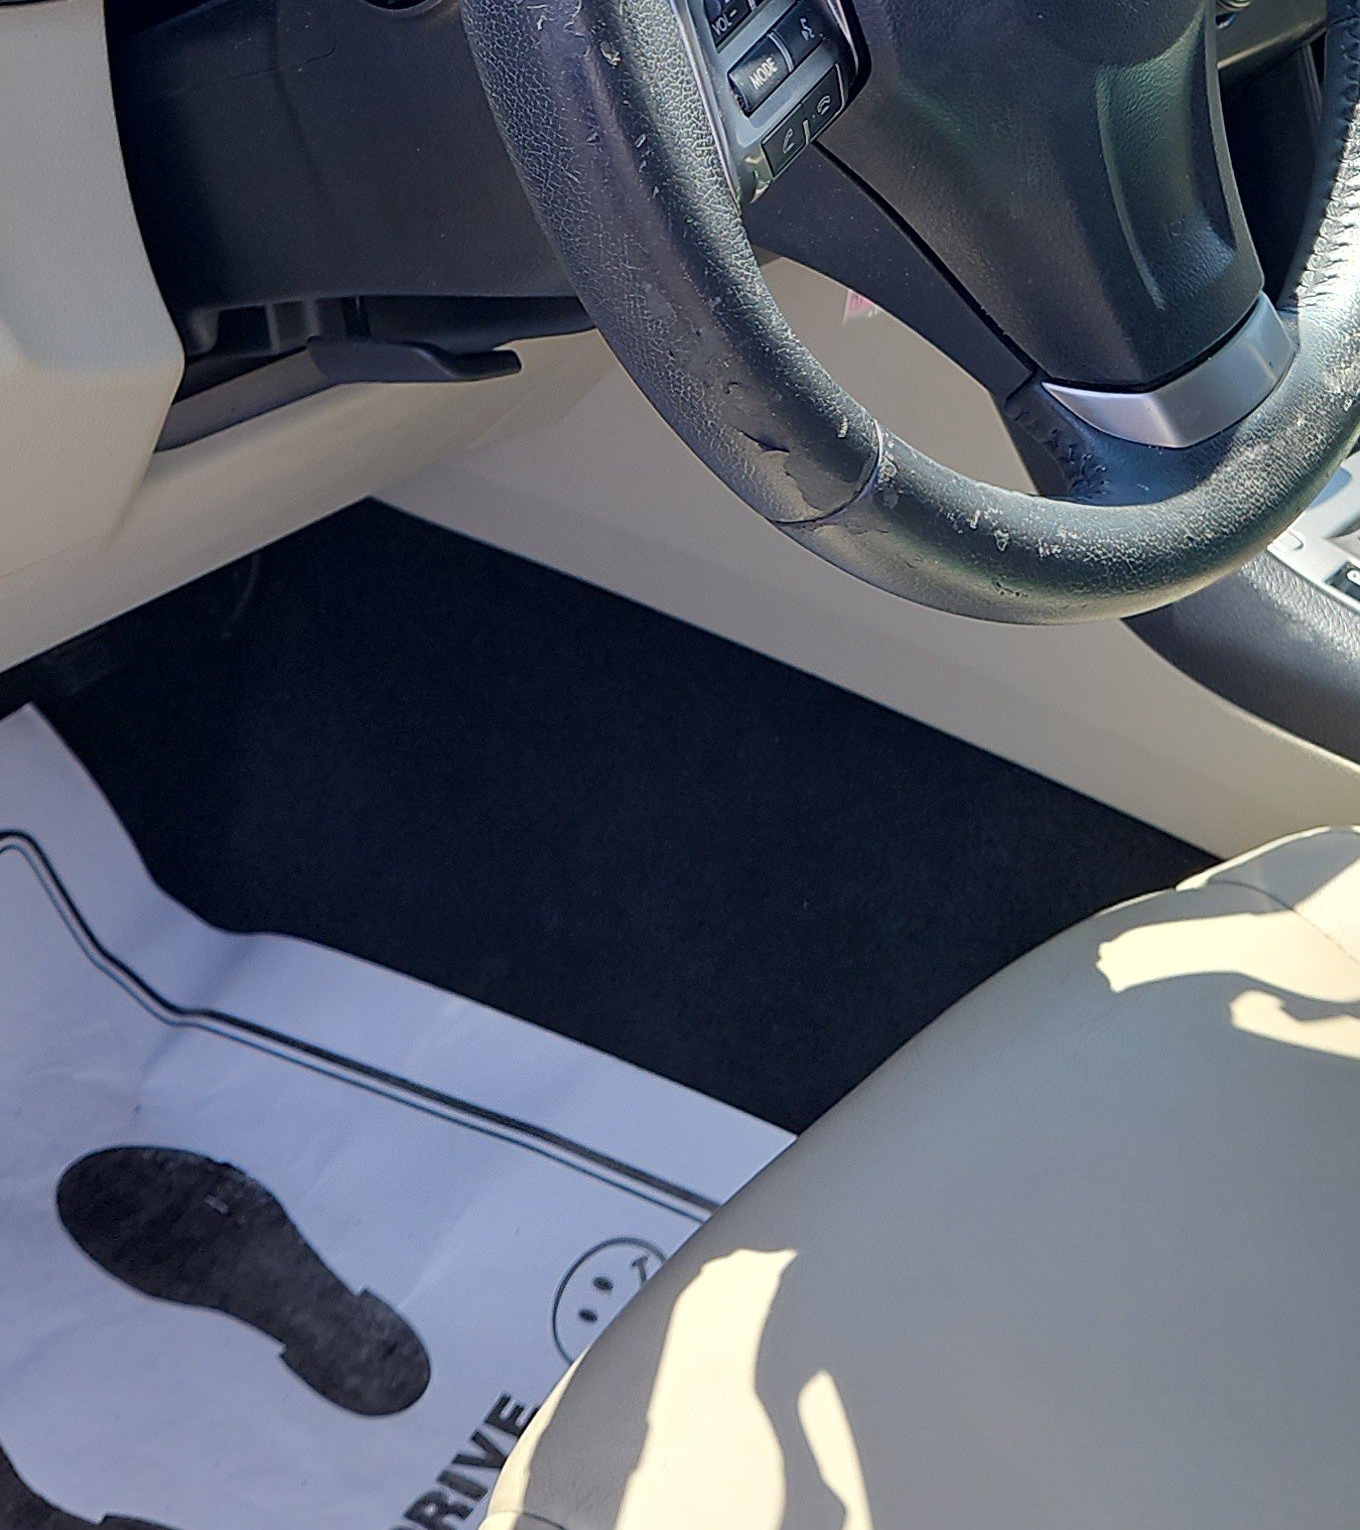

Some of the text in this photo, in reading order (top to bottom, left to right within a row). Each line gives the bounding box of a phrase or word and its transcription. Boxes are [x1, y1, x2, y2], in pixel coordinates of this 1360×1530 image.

[711, 11, 733, 36] VOL
[751, 57, 778, 90] MODE
[392, 1393, 542, 1530] RIVE
